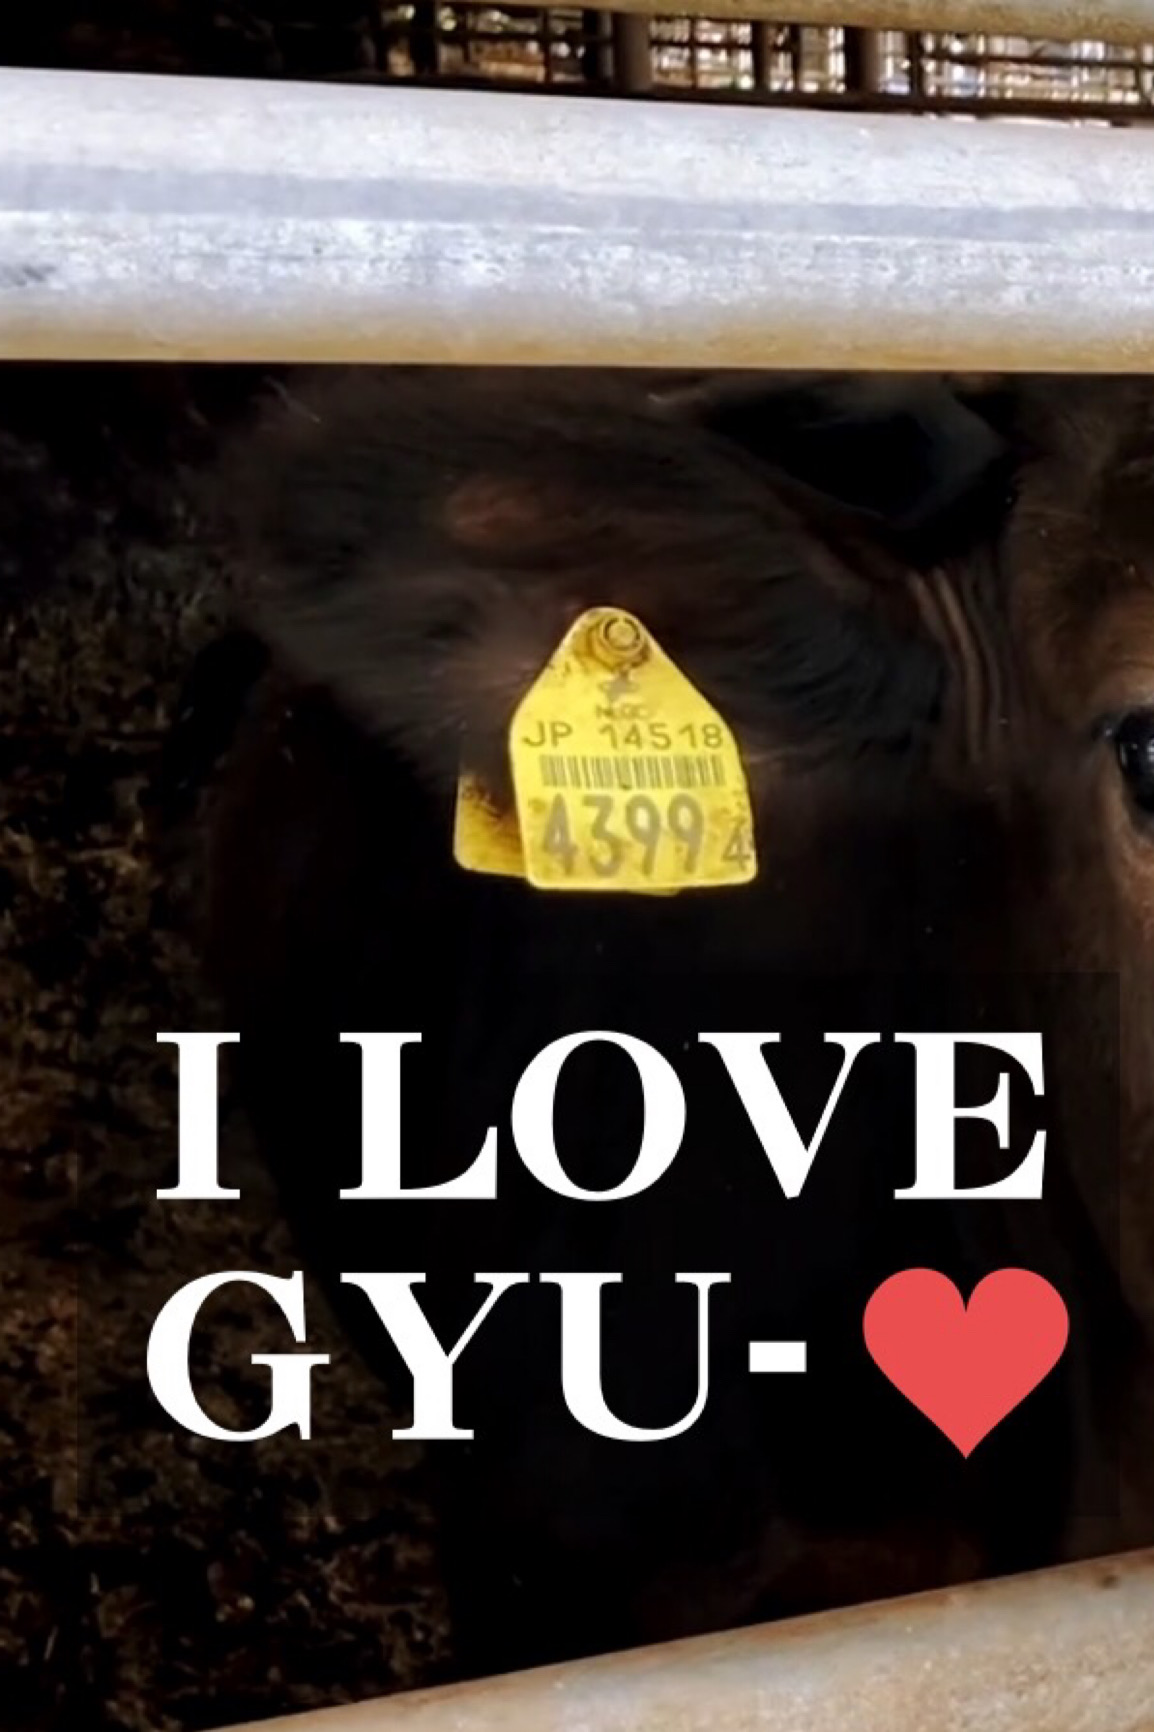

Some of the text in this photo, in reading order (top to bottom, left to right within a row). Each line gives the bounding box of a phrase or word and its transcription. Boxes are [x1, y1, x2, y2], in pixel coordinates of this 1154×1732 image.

[522, 721, 724, 751] JP 14518
[541, 792, 752, 878] 4399 4
